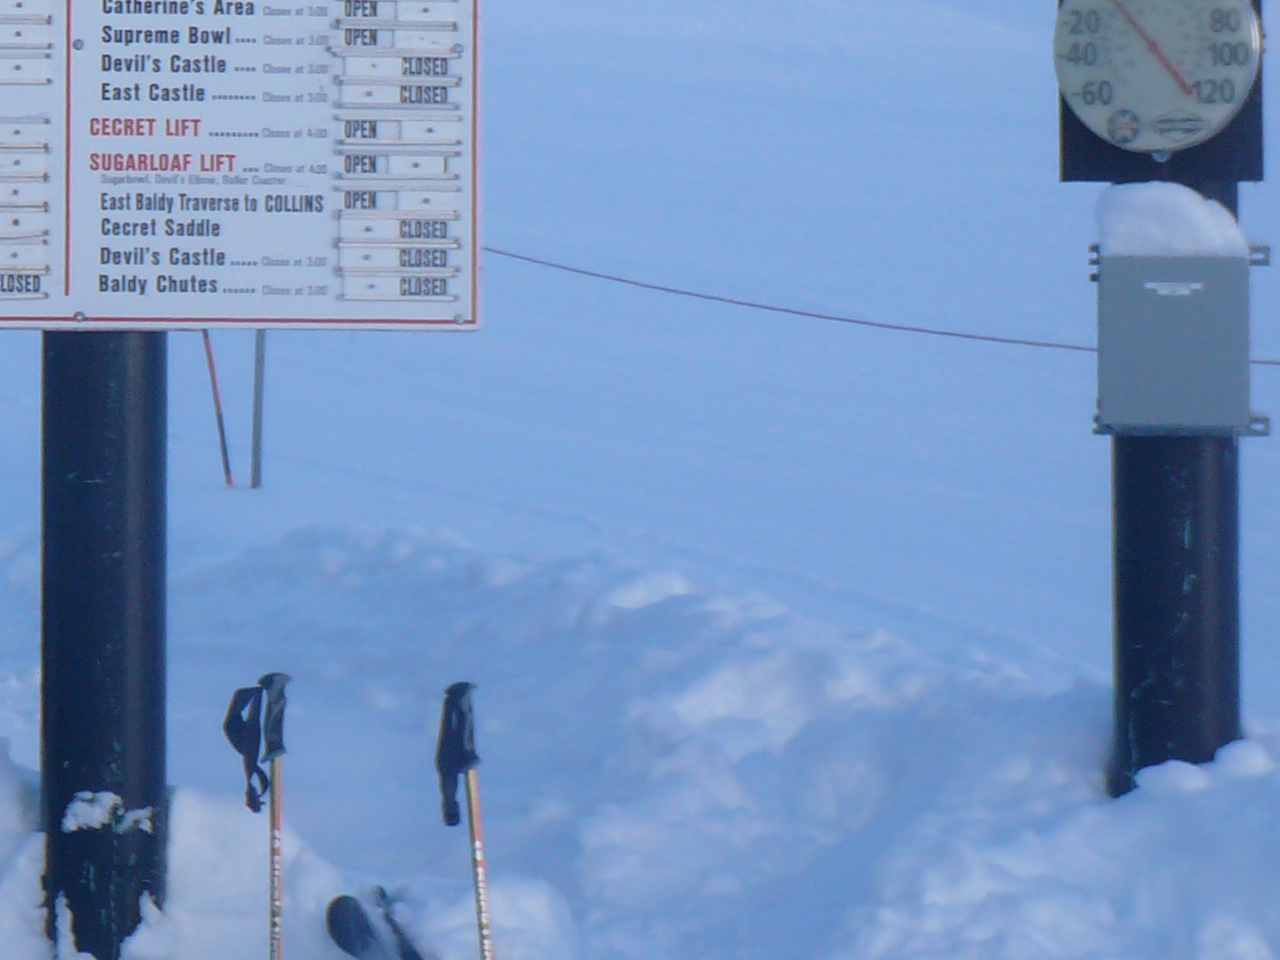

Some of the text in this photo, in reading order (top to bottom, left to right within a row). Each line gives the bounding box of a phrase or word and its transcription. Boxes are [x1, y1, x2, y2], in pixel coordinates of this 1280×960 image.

[345, 0, 377, 17] OPEN
[1210, 9, 1240, 32] 80
[102, 25, 179, 46] Supreme
[188, 27, 230, 44] Bowl
[344, 29, 377, 46] OPEN
[1209, 42, 1248, 66] 100
[101, 54, 161, 73] Devil's
[170, 55, 226, 73] Castle
[401, 58, 448, 75] CLOSED
[101, 83, 139, 101] East
[149, 84, 205, 101] Castle
[400, 86, 447, 103] CLOSED
[1193, 79, 1235, 104] 120
[90, 118, 156, 136] CECRET
[165, 119, 201, 137] LIFT
[344, 121, 377, 138] OPEN
[90, 153, 192, 171] SUGARLOAF
[200, 154, 236, 172] LIFT
[344, 156, 377, 174] OPEN
[101, 193, 324, 213] East Baldy Traverse to COLLINS
[344, 191, 376, 209] OPEN
[101, 218, 220, 237] Cecret Saddle
[399, 221, 447, 239] CLOSED
[100, 247, 160, 265] Devil's
[169, 248, 225, 266] Castle
[399, 249, 447, 267] CLOSED
[99, 275, 146, 295] Baldy
[156, 275, 218, 293] Chutes
[399, 278, 447, 296] CLOSED
